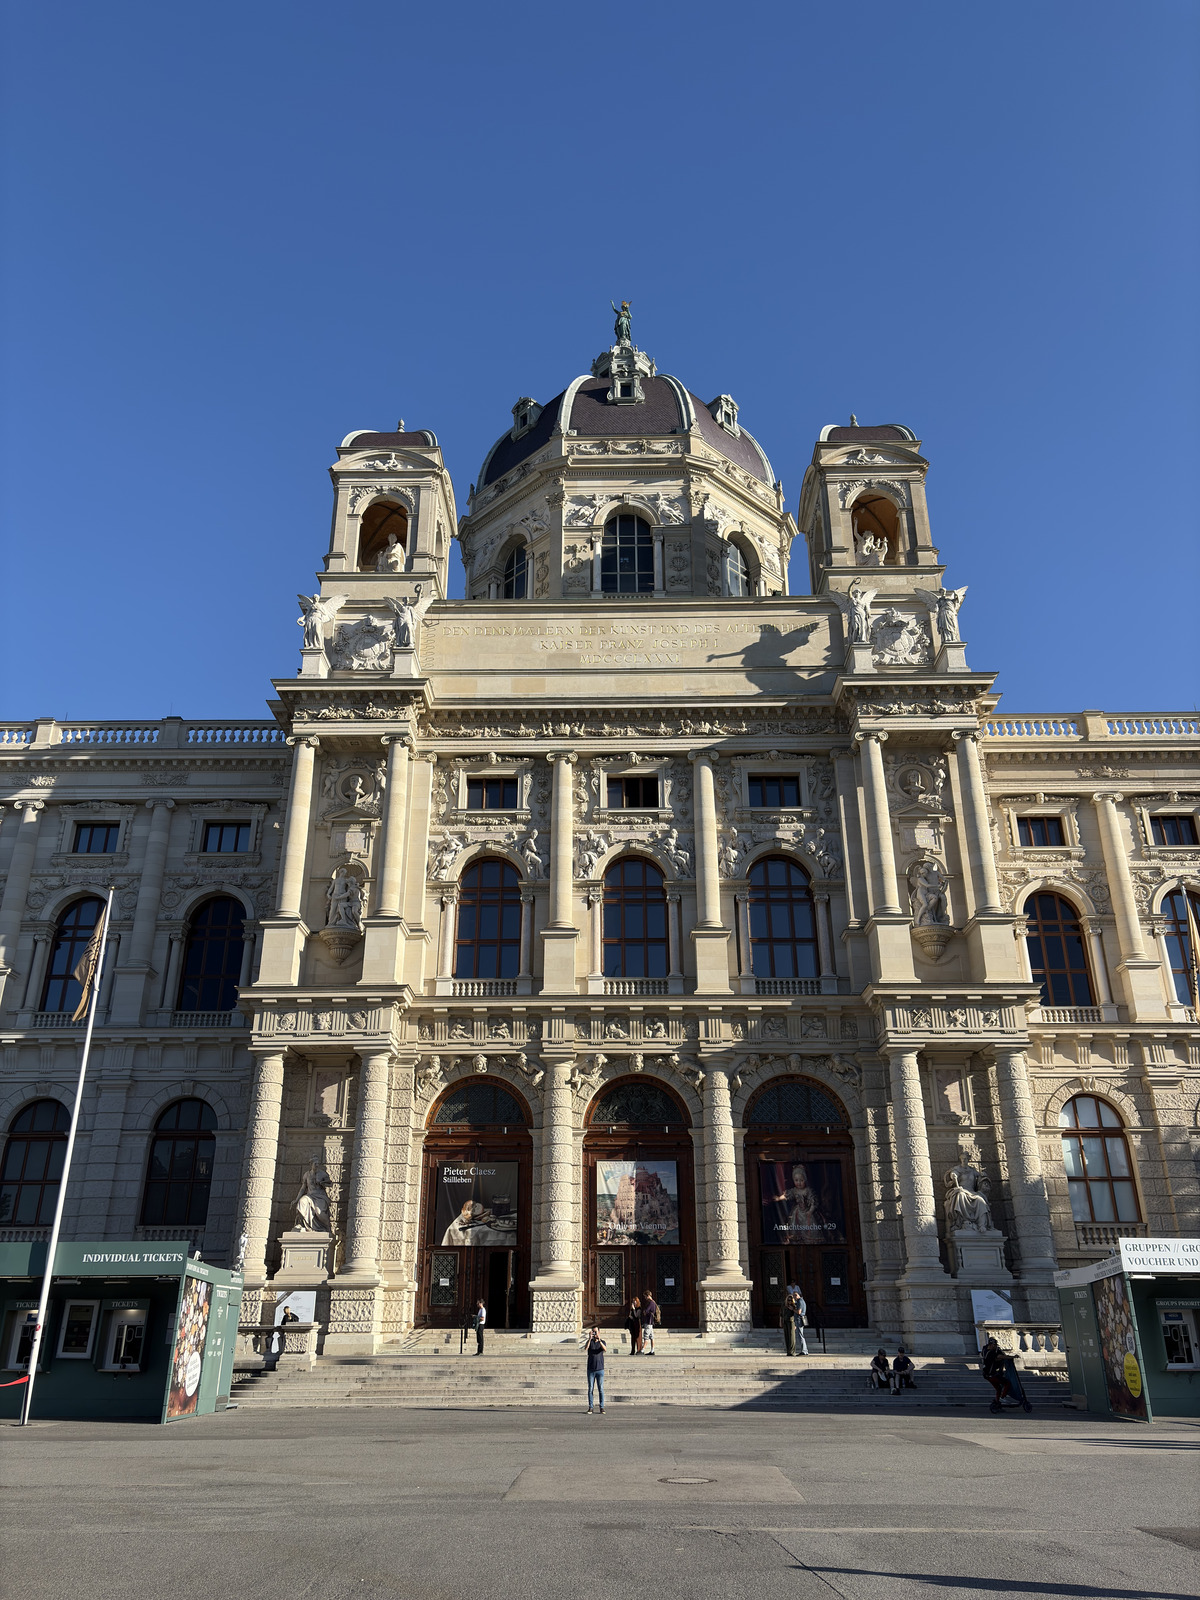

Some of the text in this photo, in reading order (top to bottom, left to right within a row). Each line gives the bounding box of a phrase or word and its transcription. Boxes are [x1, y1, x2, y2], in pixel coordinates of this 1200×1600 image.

[442, 626, 470, 636] DEN
[580, 625, 606, 635] DER
[610, 625, 656, 635] KUNST
[660, 625, 689, 635] UND
[694, 624, 720, 634] DES
[539, 640, 593, 650] KAISER
[600, 640, 644, 649] FRANZ
[652, 639, 709, 649] JOSEPH
[579, 653, 680, 664] MDCCCLXXXI
[443, 1167, 496, 1176] Pieter Claesz
[442, 1176, 472, 1184] Stillleben
[608, 1222, 667, 1232] Only in Vienna
[773, 1222, 822, 1231] Ansichtssache
[1124, 1243, 1171, 1253] GRUPPEN
[82, 1253, 184, 1263] INDIVIDUAL TICKETS
[1127, 1257, 1199, 1267] VOUCHER UND
